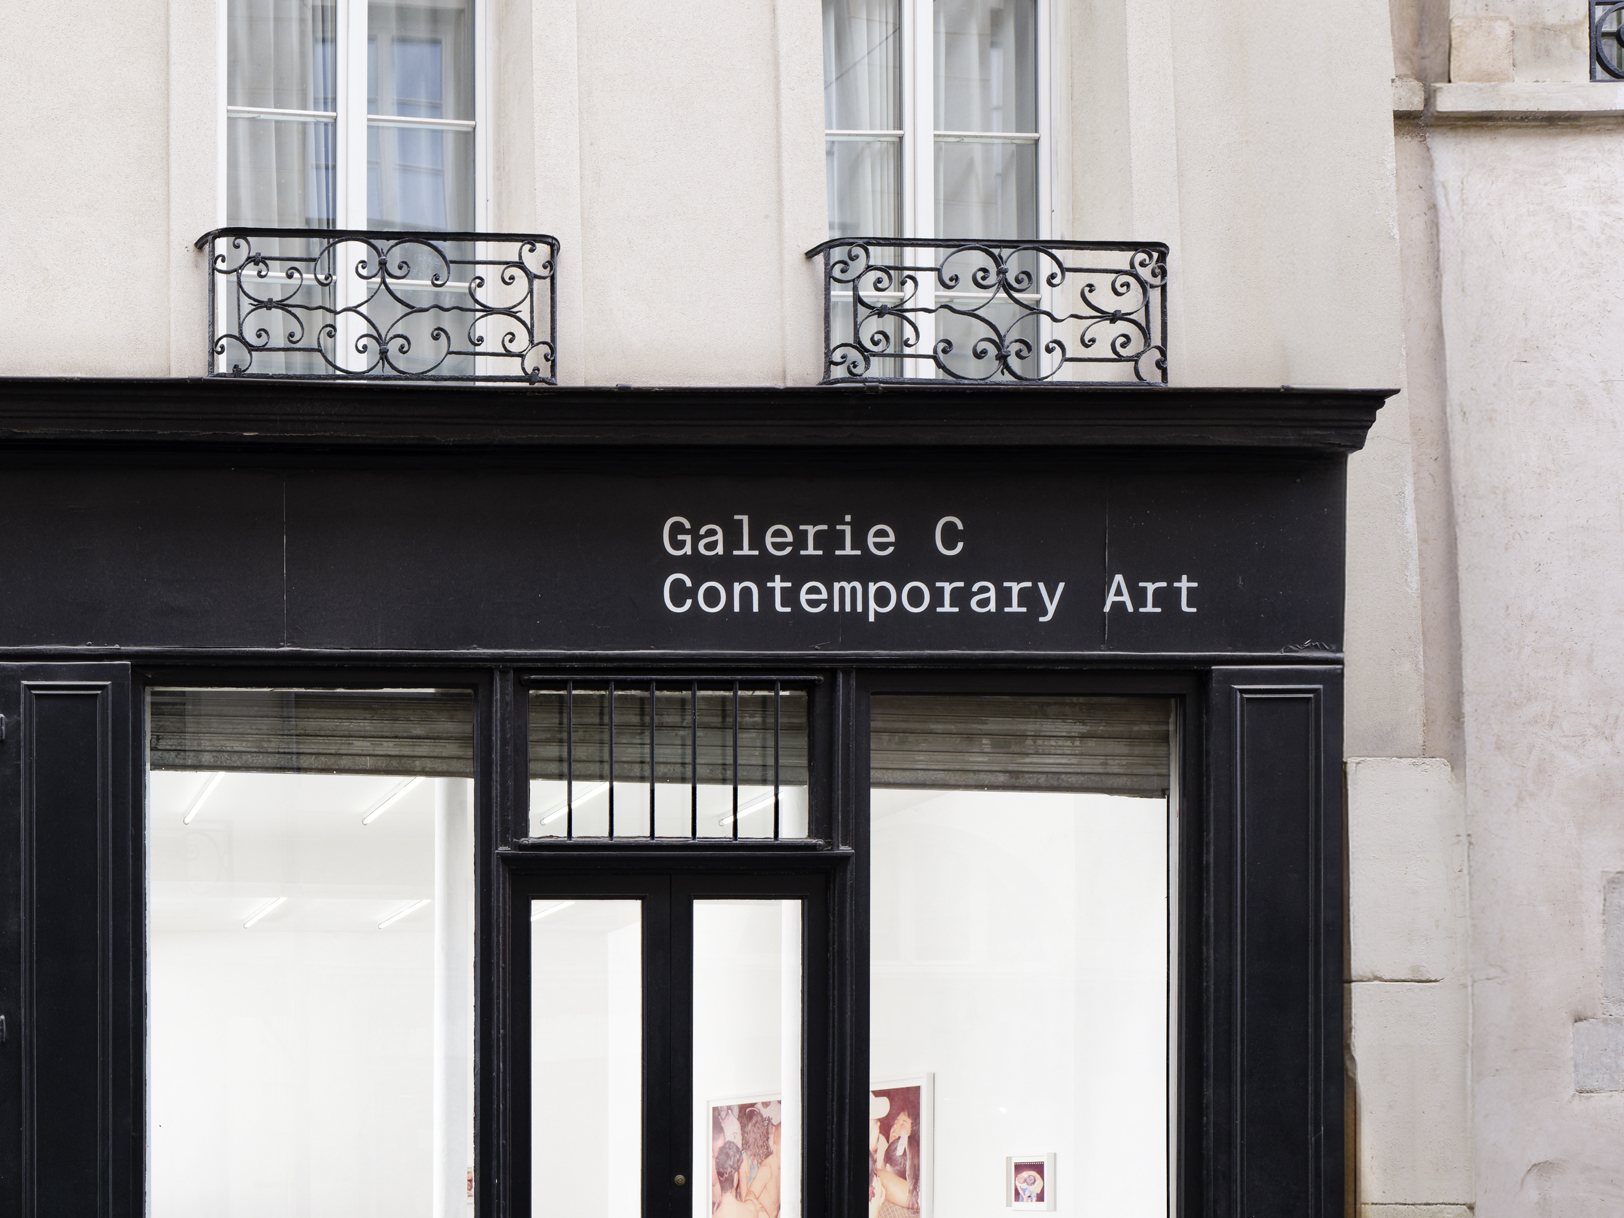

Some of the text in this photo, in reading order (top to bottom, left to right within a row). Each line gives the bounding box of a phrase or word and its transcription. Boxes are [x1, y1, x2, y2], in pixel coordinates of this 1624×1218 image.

[663, 515, 963, 556] Galerie C
[664, 573, 1198, 622] Contemporary Art
